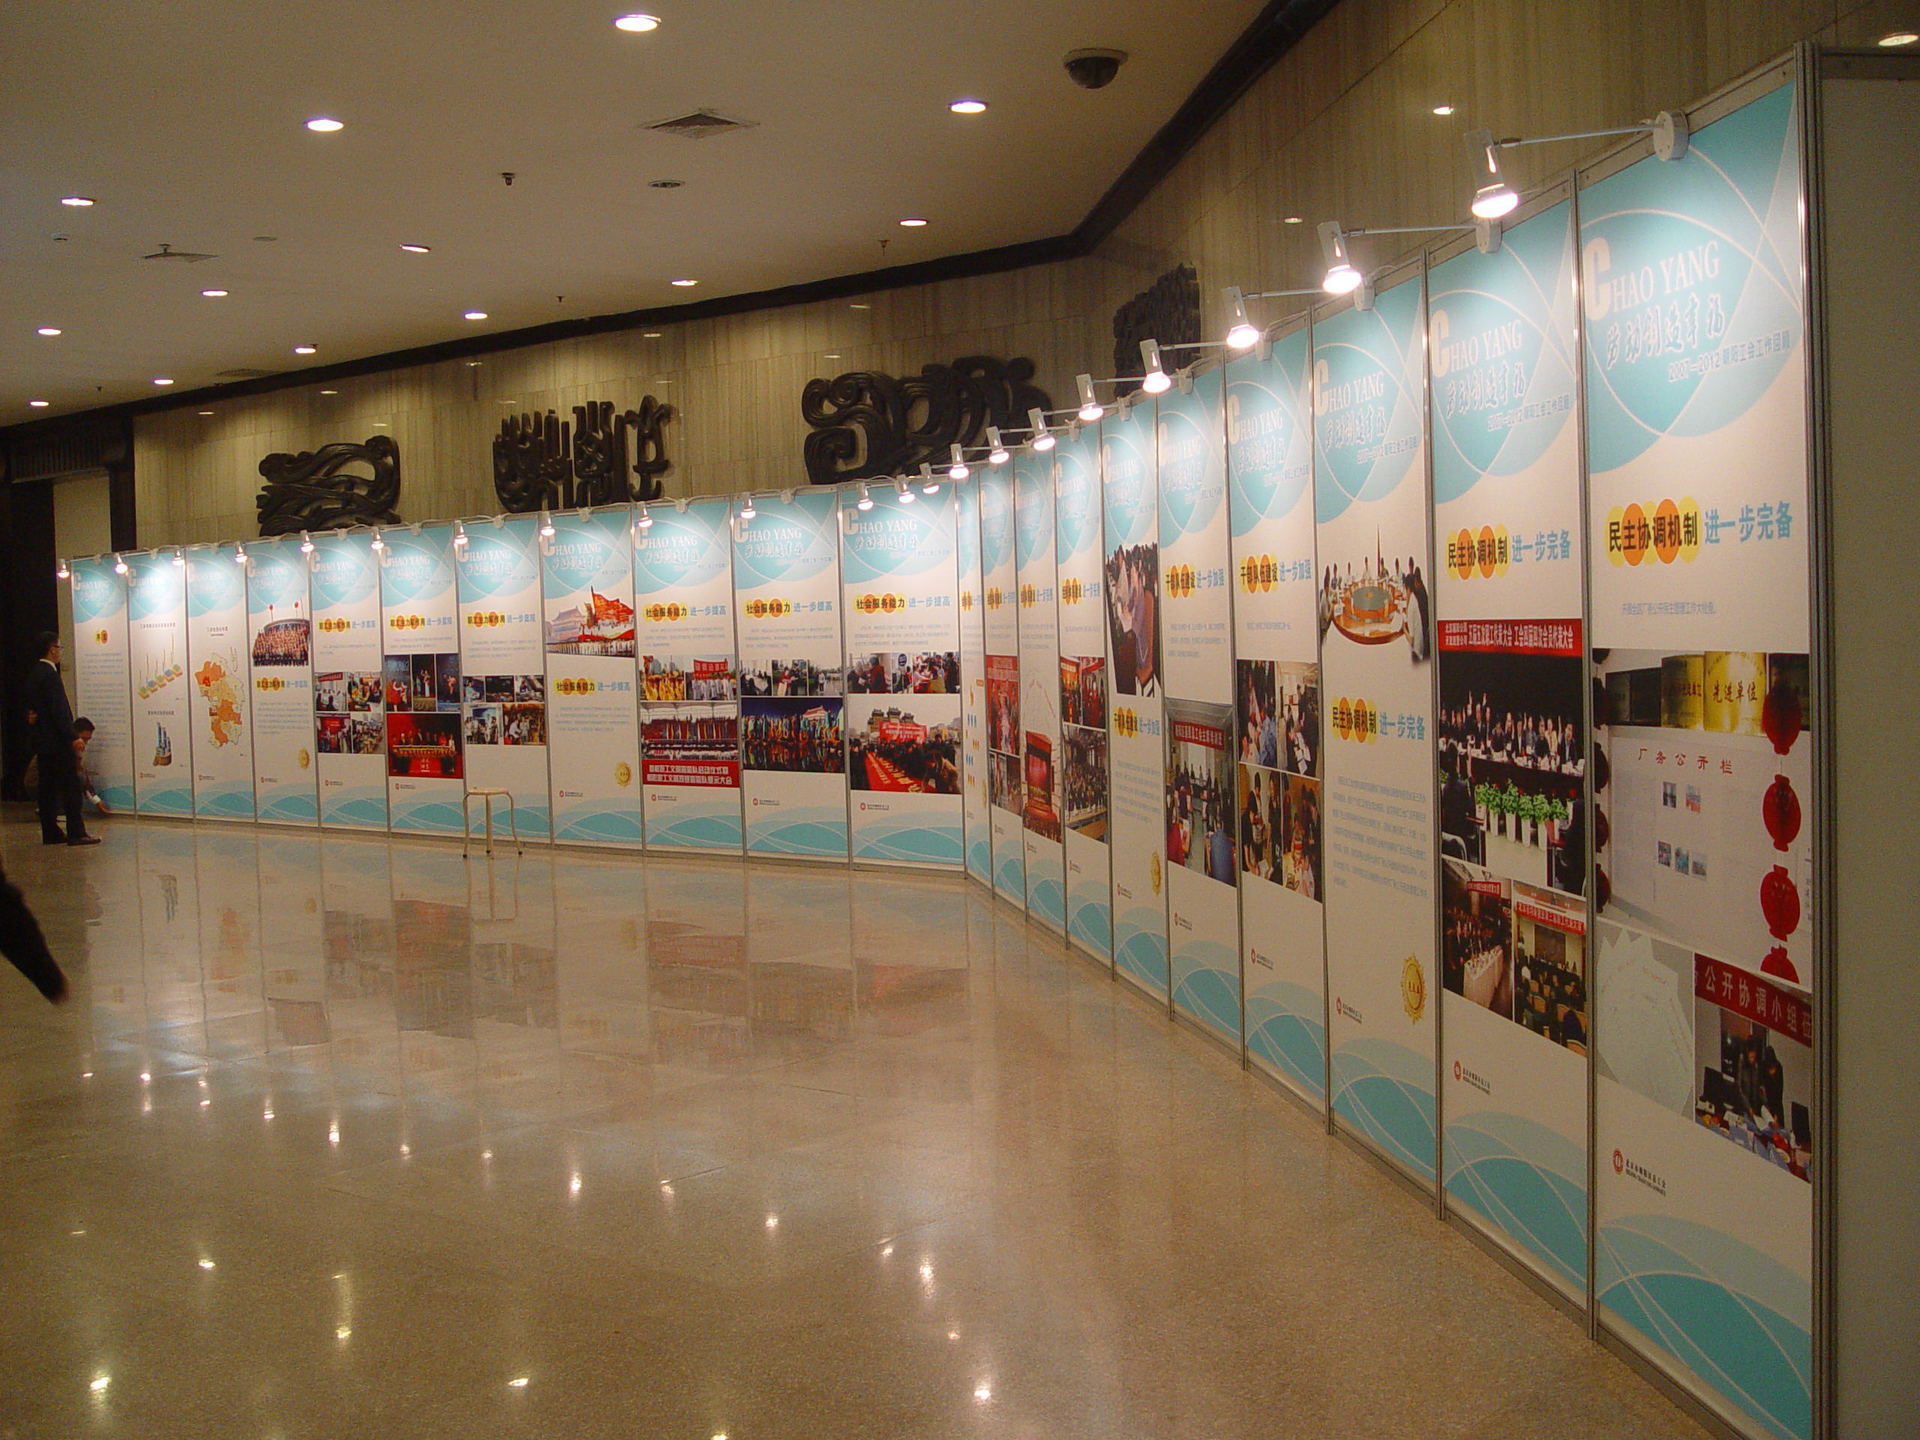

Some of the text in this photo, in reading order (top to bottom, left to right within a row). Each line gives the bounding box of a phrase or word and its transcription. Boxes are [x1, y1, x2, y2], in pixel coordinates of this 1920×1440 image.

[1585, 237, 1720, 321] CHAO YANG
[1431, 309, 1523, 378] CHAO YANG
[1314, 359, 1385, 417] CHAO YANG
[635, 524, 698, 549] CHAO YANG
[734, 518, 802, 543] CHAO YANG
[844, 508, 918, 535] CHAO YANG
[1608, 501, 1793, 553] 民主协调机制 进一步完备
[1448, 529, 1571, 569] 民主协调机制 进一步完备
[1712, 680, 1758, 704] 先进单位
[1638, 748, 1734, 775] 厂务公开栏
[1695, 965, 1812, 1039] 公开协调小组
